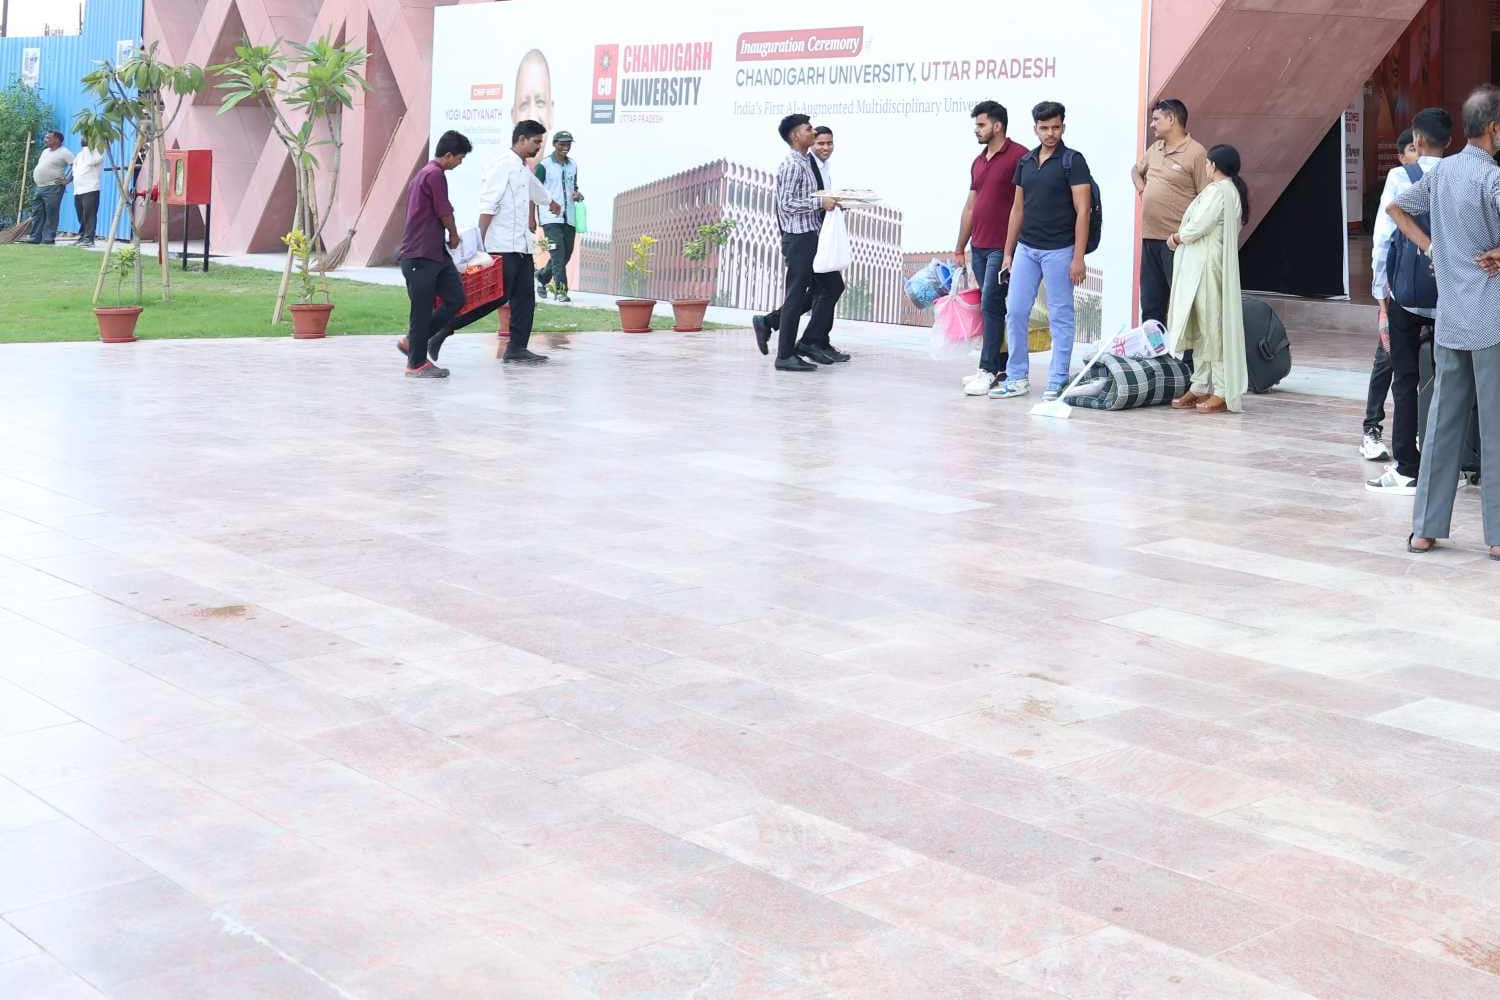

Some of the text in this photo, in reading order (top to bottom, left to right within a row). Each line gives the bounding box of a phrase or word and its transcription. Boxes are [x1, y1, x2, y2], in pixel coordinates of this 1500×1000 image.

[623, 41, 713, 73] CHANDIGARH
[740, 37, 804, 57] Inauguration
[808, 36, 860, 54] Ceremony
[736, 57, 1056, 87] CHANDIGARH UNIVERSITY, UTTAR PRADESH
[597, 77, 612, 96] CU
[620, 77, 702, 106] UNIVERSITY
[446, 109, 461, 120] YOGI
[733, 101, 762, 115] India's
[764, 100, 785, 114] First
[856, 96, 942, 117] Multidisciplinary
[944, 95, 986, 113] Unive
